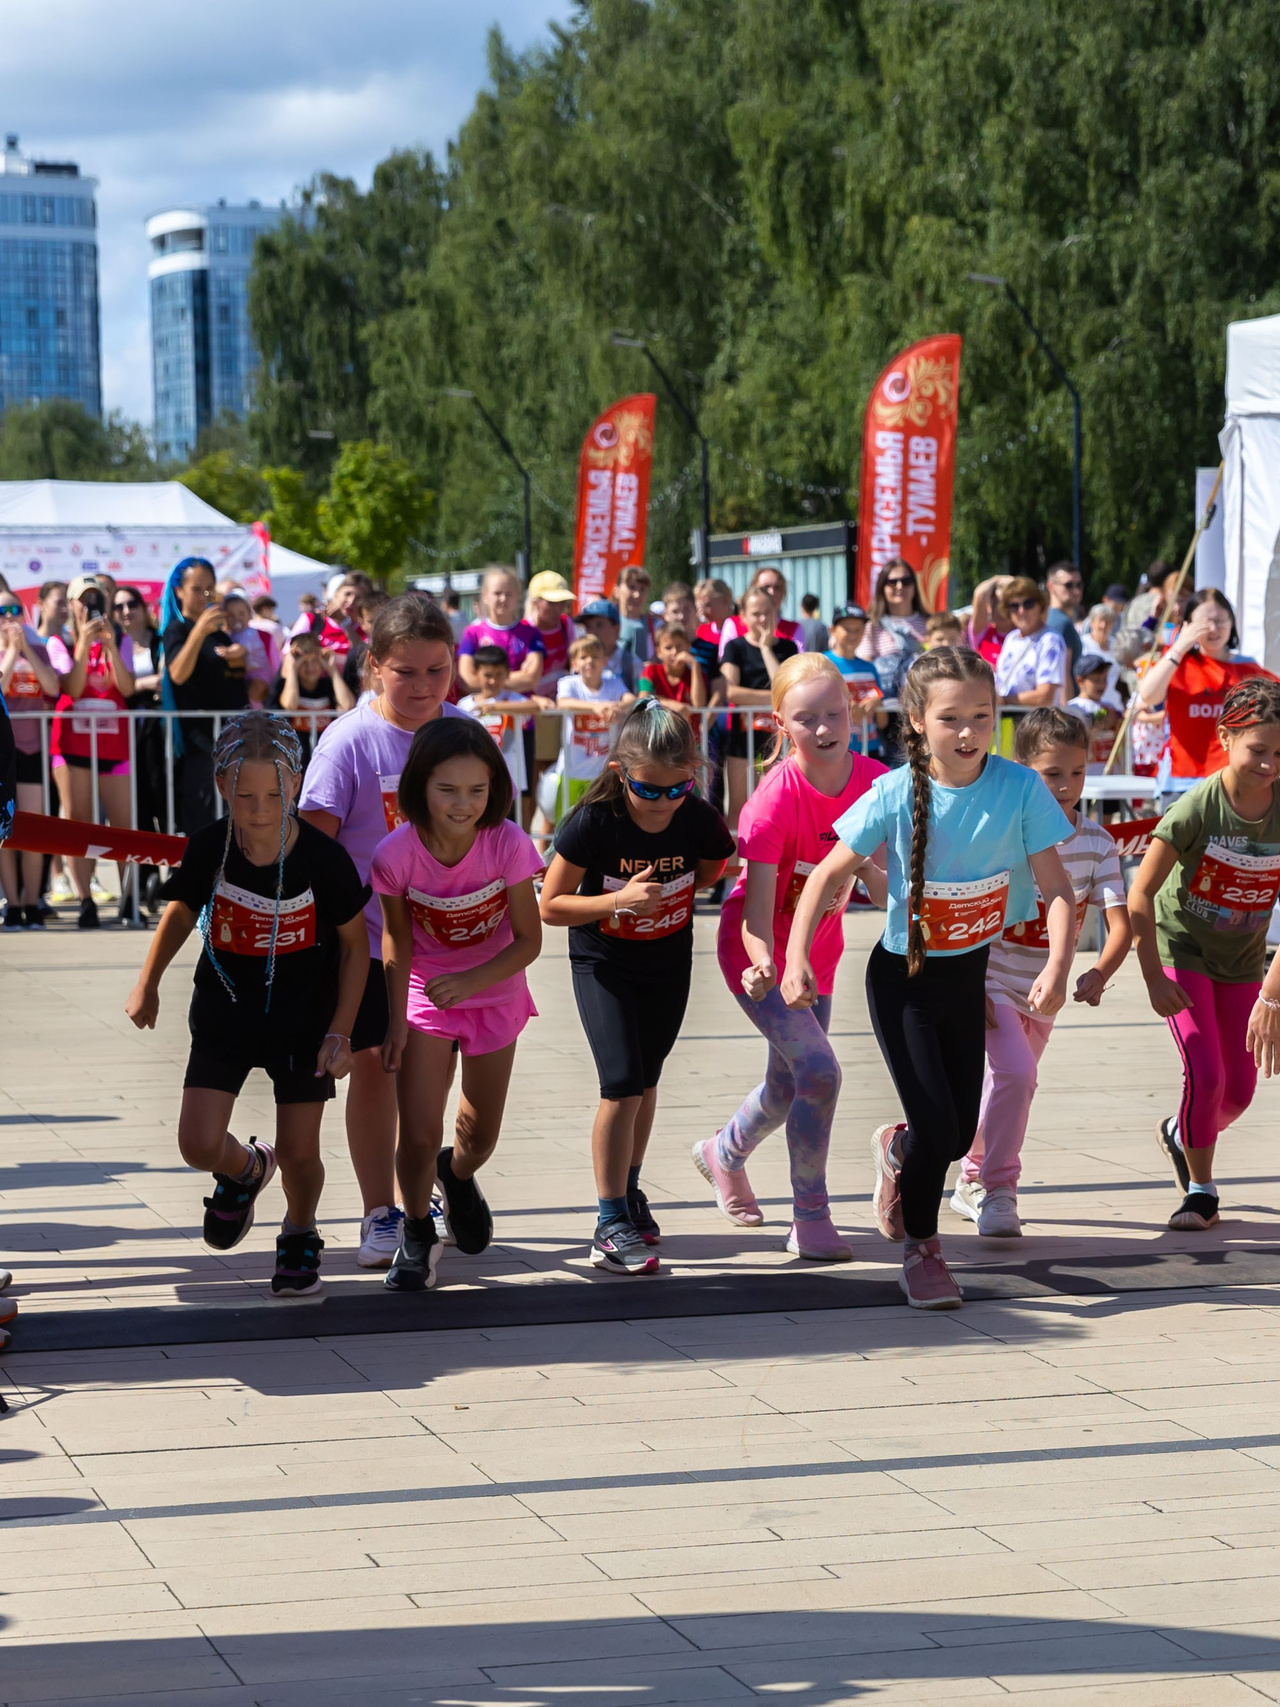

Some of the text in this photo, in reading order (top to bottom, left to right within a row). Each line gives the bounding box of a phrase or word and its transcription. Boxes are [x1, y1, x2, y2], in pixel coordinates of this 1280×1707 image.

[905, 435, 938, 547] -ТУМАЕВ
[611, 472, 640, 562] -ТУМАЕВ
[1188, 703, 1224, 718] ВОЛ
[819, 830, 841, 842] FIL
[619, 855, 685, 873] NEVER
[1221, 886, 1275, 904] 232
[1185, 899, 1209, 919] CLUB
[634, 906, 688, 933] 248
[947, 910, 1001, 941] 242
[253, 927, 306, 948] 231
